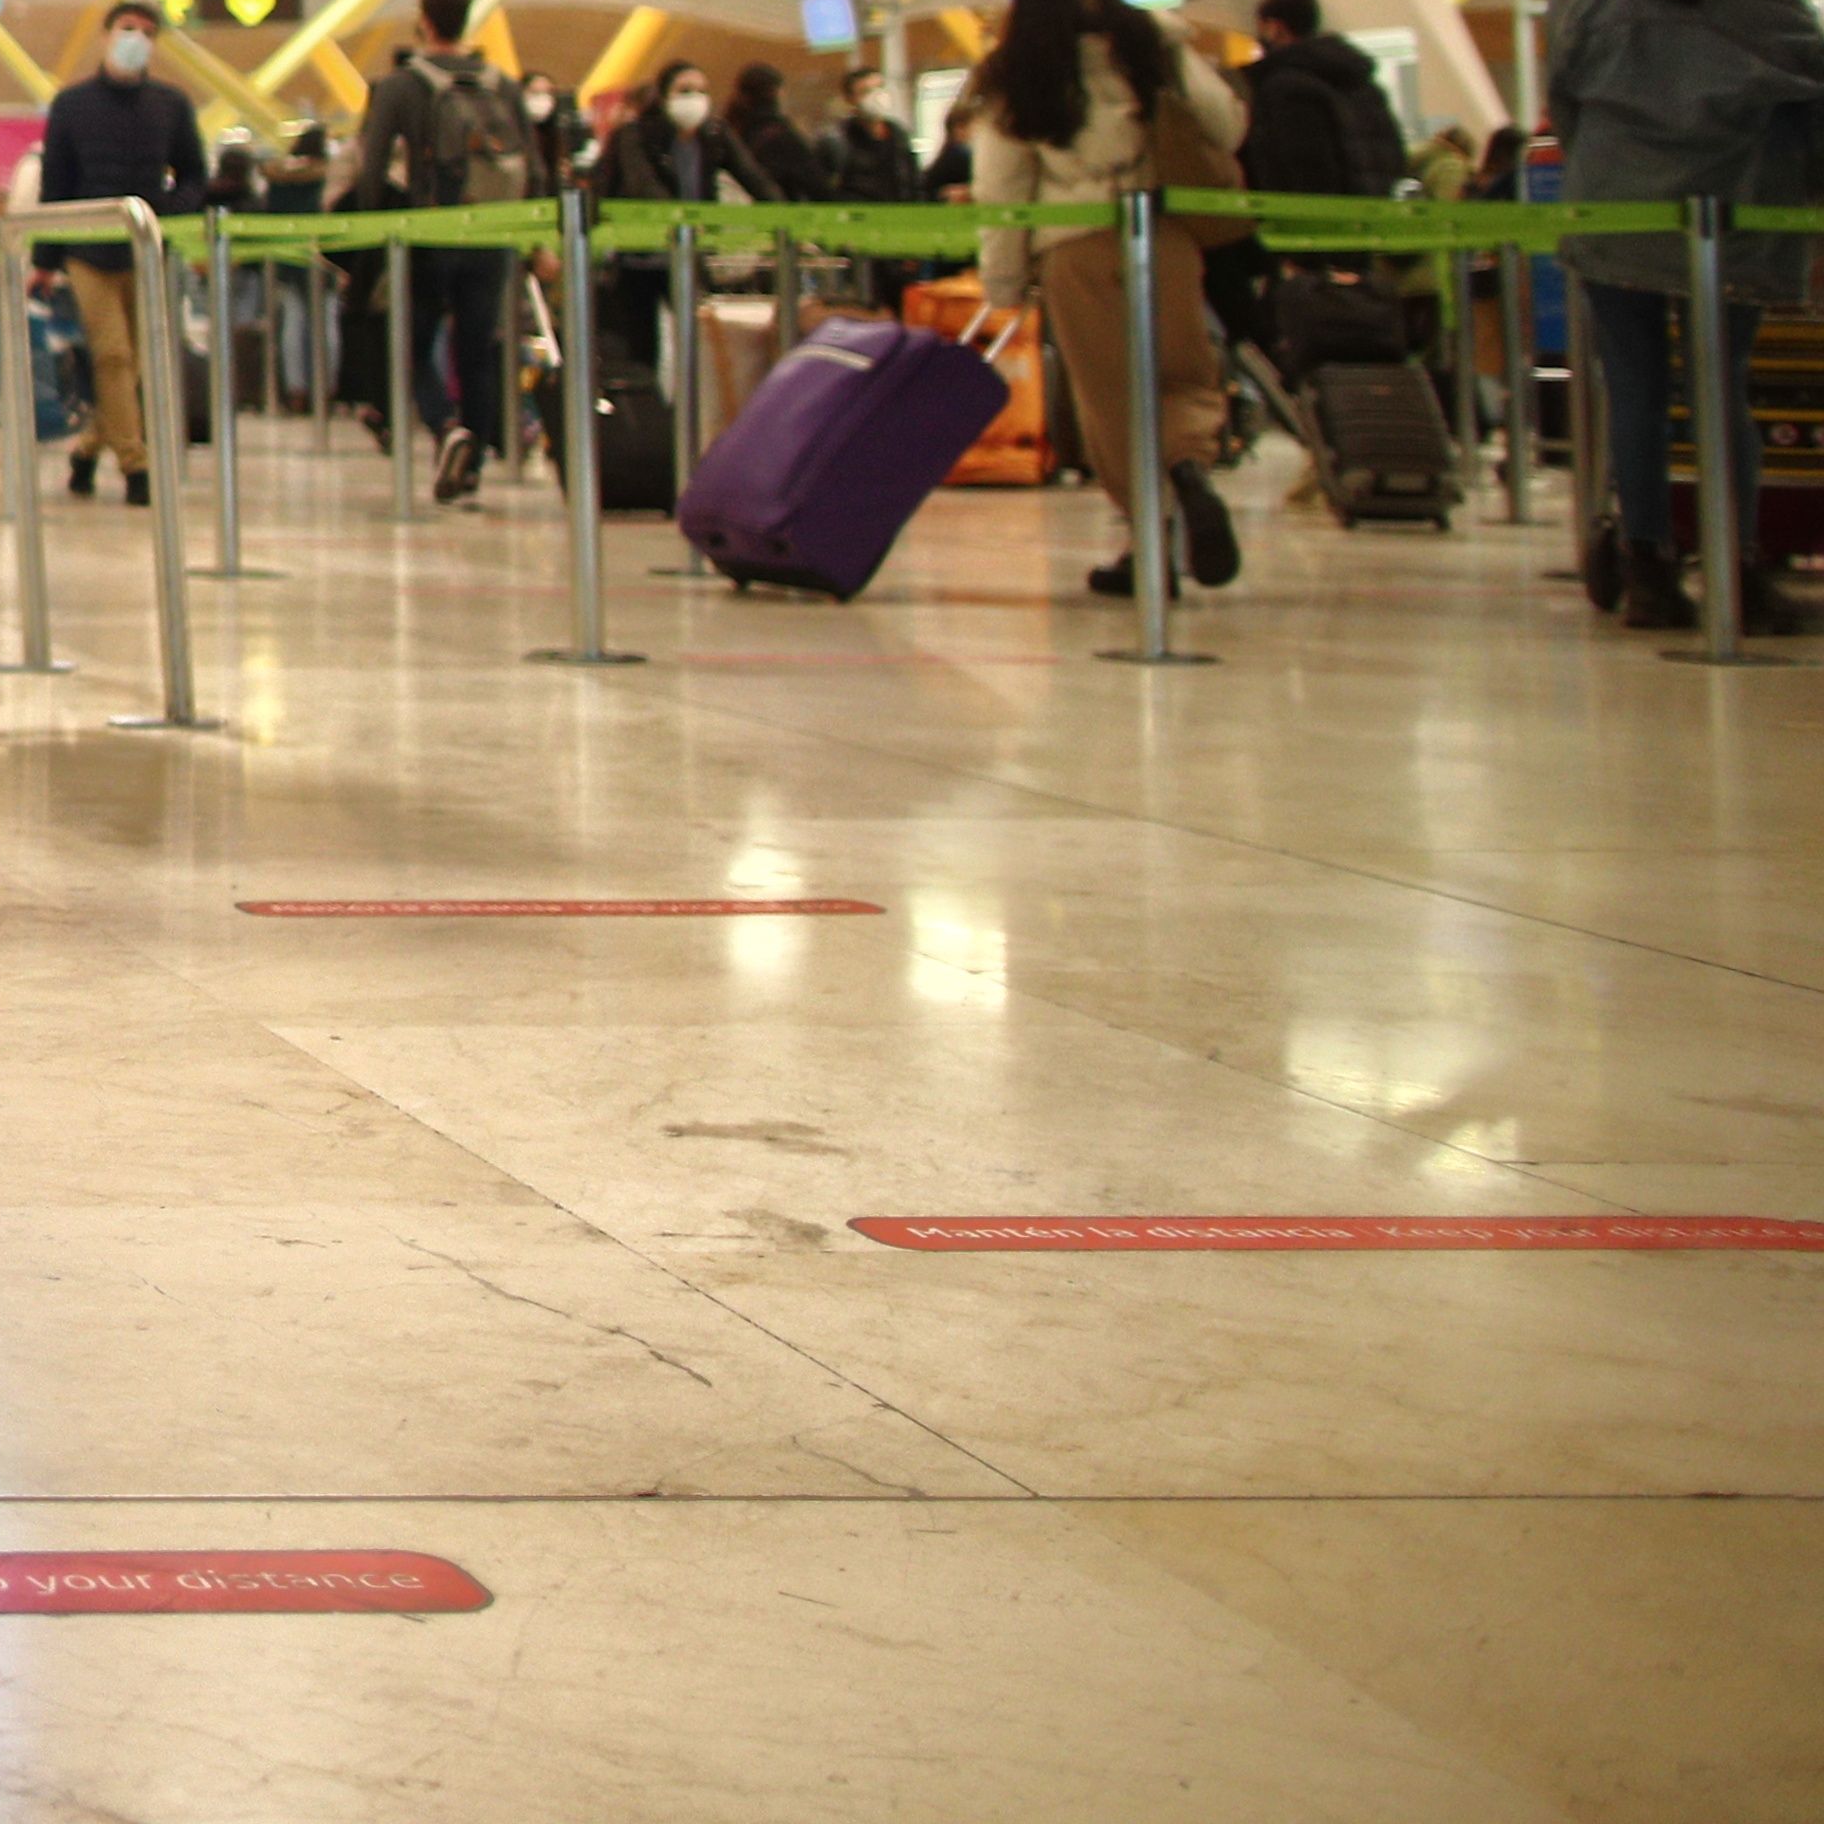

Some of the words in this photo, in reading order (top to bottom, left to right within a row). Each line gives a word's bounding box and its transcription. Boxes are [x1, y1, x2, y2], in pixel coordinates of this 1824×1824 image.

[906, 1225, 1083, 1239] Mantén
[1087, 1226, 1139, 1238] la
[1147, 1226, 1356, 1239] distancia
[26, 1571, 154, 1594] your
[176, 1569, 425, 1591] distance
